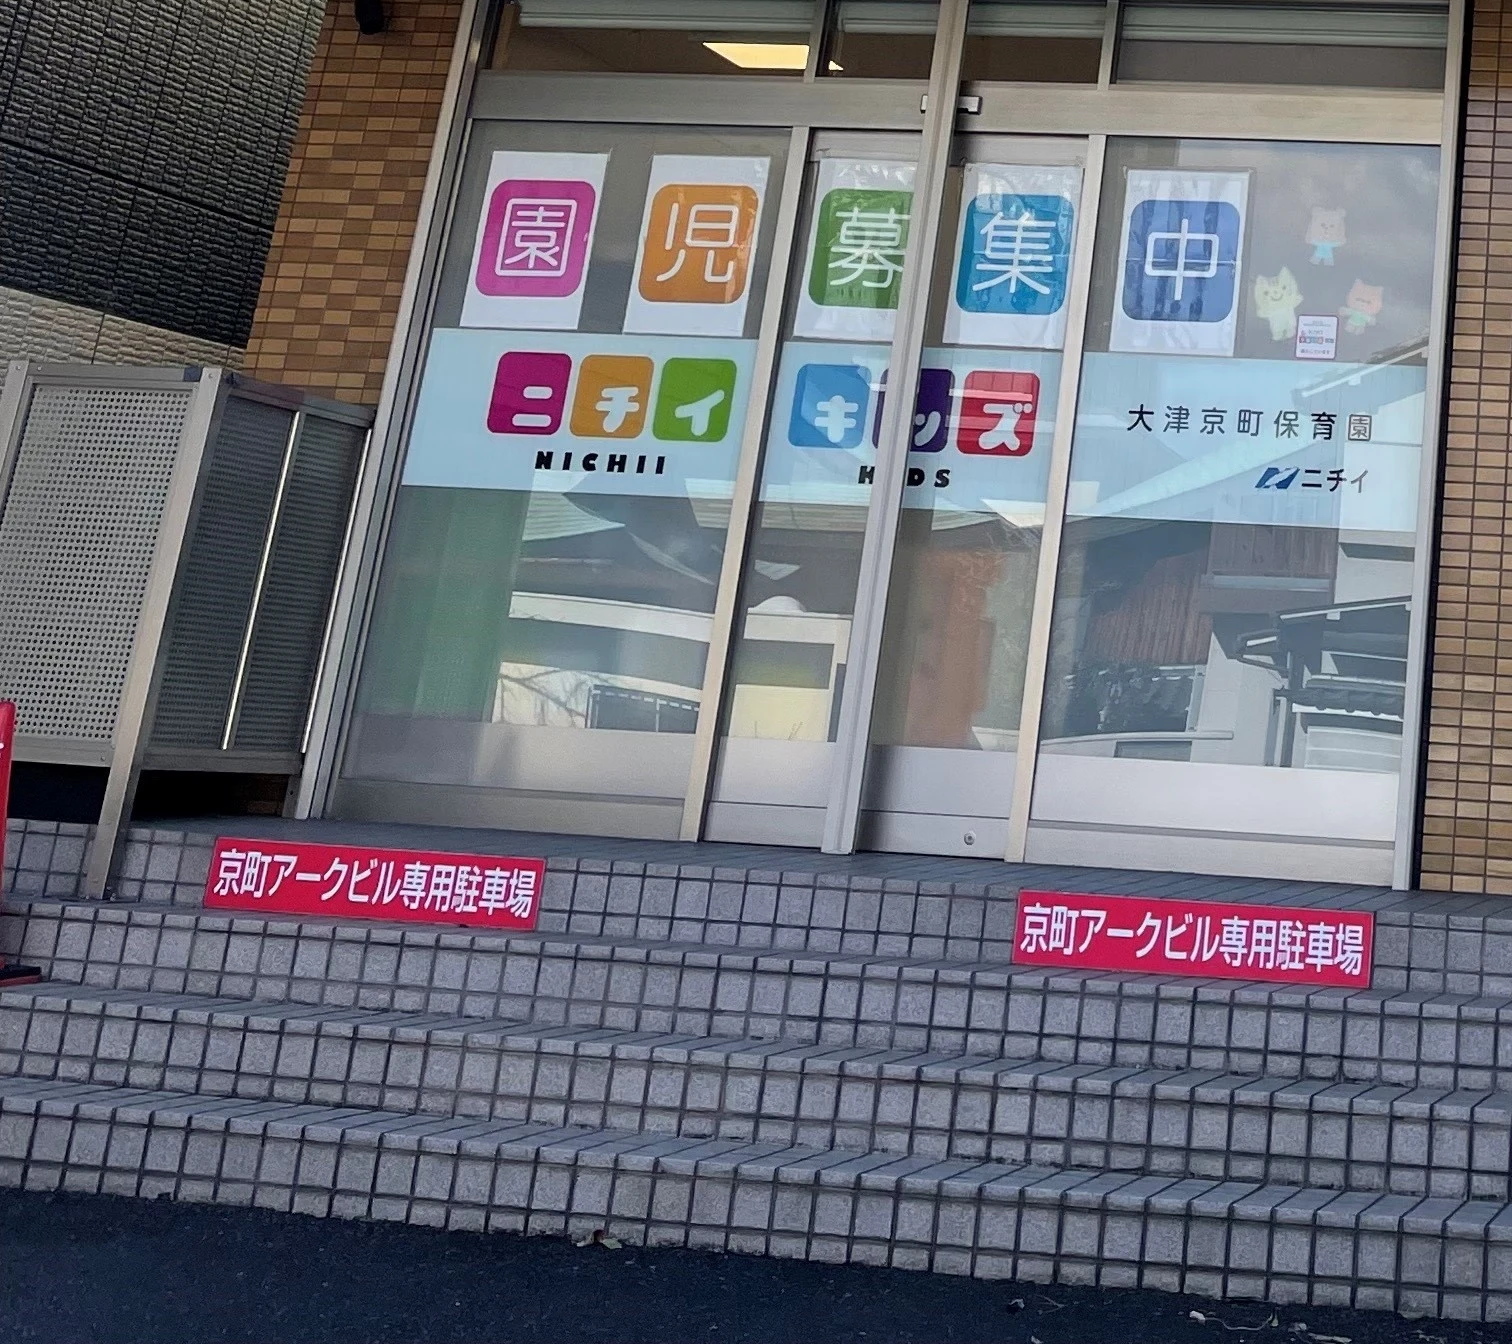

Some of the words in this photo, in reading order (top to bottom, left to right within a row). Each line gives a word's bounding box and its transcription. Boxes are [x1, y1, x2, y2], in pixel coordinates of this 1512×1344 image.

[494, 197, 1219, 302] 園児募集中
[1127, 403, 1373, 442] 大津京町保育園
[534, 449, 667, 476] NICHII
[858, 465, 951, 488] KDS
[1301, 468, 1369, 494] ニチイ
[212, 847, 536, 920] 京町アークビル専用駐車場
[1019, 901, 1364, 976] 京町アークビル専用駐車場
